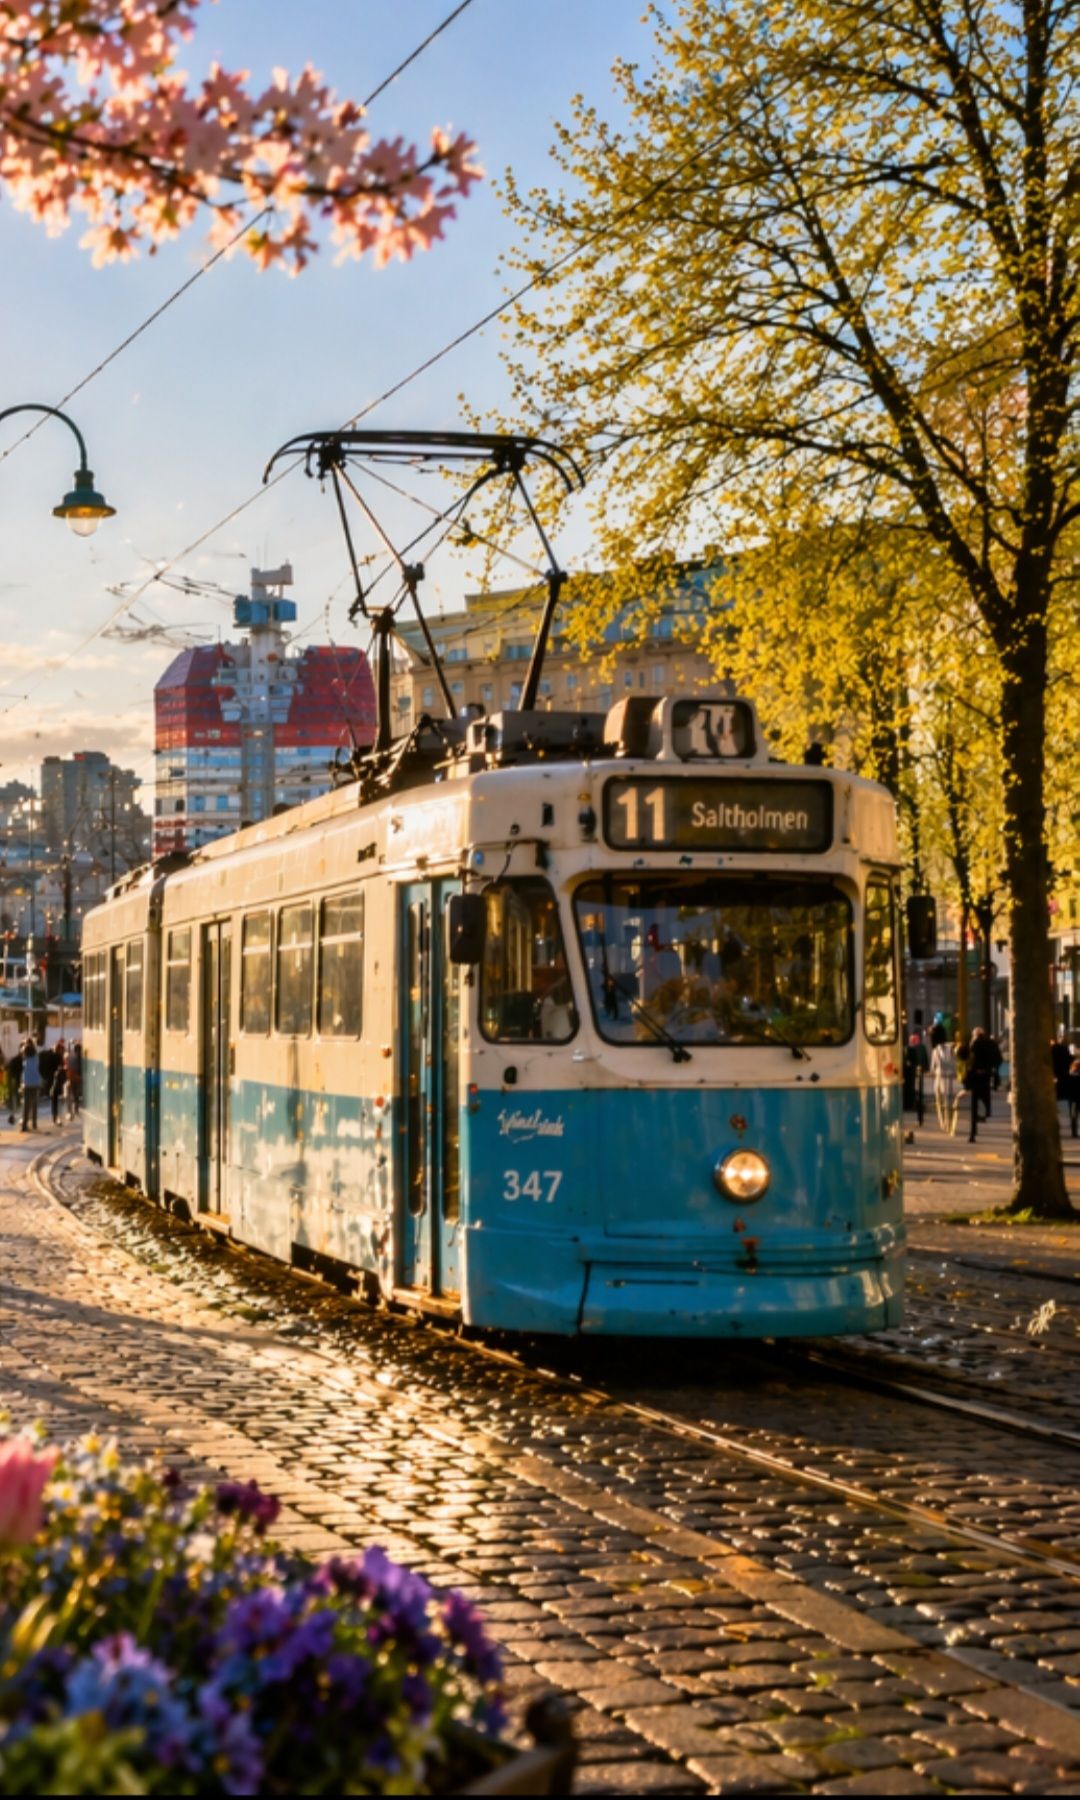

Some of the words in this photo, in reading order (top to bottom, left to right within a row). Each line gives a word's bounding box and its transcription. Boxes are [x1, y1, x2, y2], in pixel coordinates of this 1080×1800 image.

[617, 787, 665, 841] 11
[691, 801, 808, 829] Saltholmen
[503, 1169, 563, 1203] 347
